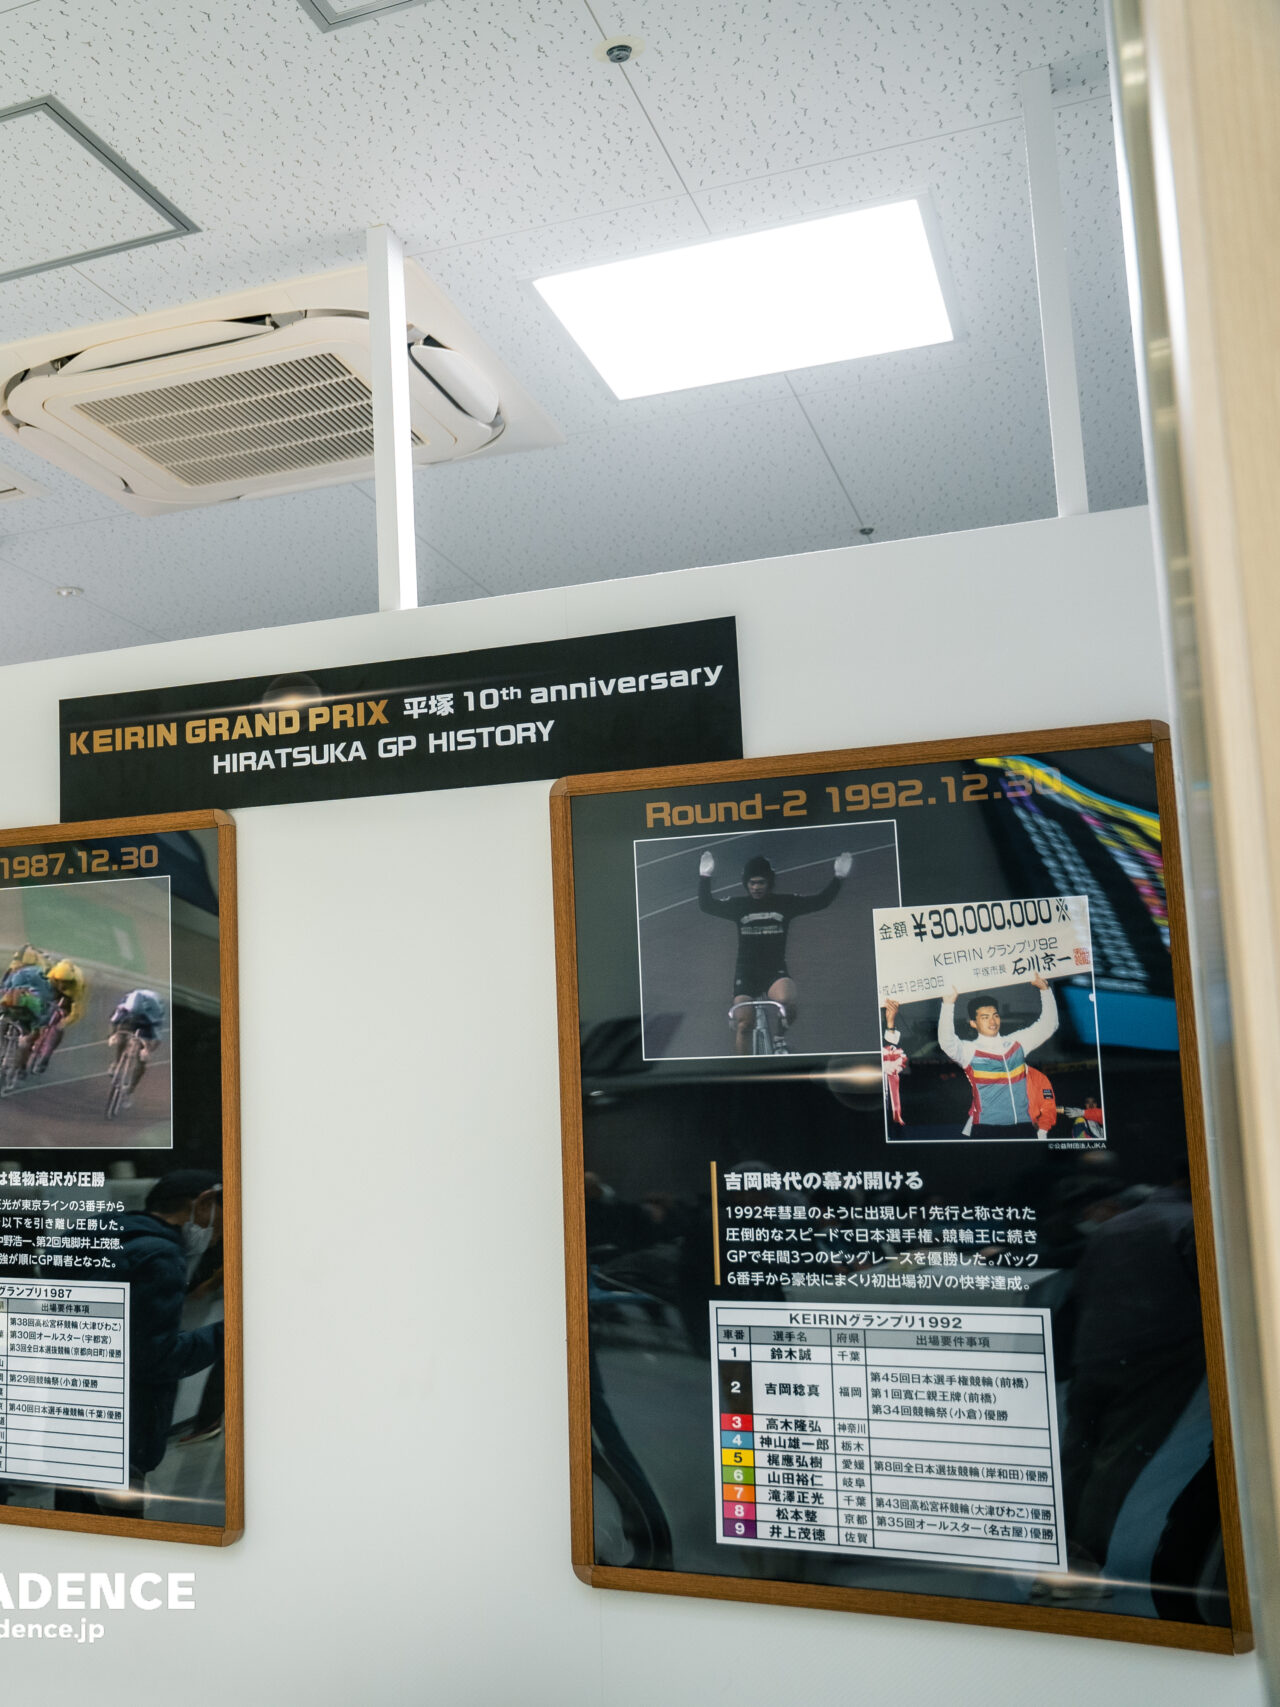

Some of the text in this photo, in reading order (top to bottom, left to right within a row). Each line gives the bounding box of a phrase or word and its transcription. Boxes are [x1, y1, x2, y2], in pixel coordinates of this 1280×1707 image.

[69, 663, 723, 755] KEIRIN GRAND PRIX 平塚 10th anniversary
[212, 719, 555, 775] HIRATSUKA GP HISTORY
[646, 767, 1062, 828] Round-2 1992.12.30
[0, 845, 159, 880] 1987.12.30
[878, 921, 908, 941] 金額
[933, 948, 983, 967] KEIRIN
[880, 976, 944, 996] 成4年12月30日
[723, 1170, 923, 1191] 吉岡時代の幕が開ける
[725, 1205, 1036, 1222] 1992年彗星のように出現しF1先行と称された
[726, 1227, 1037, 1244] 圧倒的なスピードで日本選手権、競輪王に続き
[726, 1250, 1039, 1267] GPで年間3つのビッグレースを優勝した。バック
[727, 1271, 1031, 1291] 6番手から豪快にまくり初出場初Vの快挙達成。
[41, 1303, 90, 1314] 出場要件事項
[789, 1312, 962, 1330] KEIRINグランプリ1992
[723, 1329, 990, 1349] 車番 選手名 府県 出場要件事項
[730, 1346, 861, 1362] 1 鈴木誠 千葉
[730, 1381, 741, 1394] 2
[839, 1385, 862, 1399] 福岡
[870, 1370, 1030, 1390] 第45回日本選手権競輪(前橋)
[870, 1387, 998, 1405] 第1回寛仁親王牌(前橋)
[872, 1404, 1009, 1422] 第34回競輪祭(小倉)優勝
[732, 1416, 866, 1436] 3 高木隆弘 神奈川
[731, 1434, 864, 1453] 4 神山雄一郎 栃木
[733, 1452, 743, 1464] 5
[842, 1458, 865, 1471] 愛媛
[873, 1460, 1049, 1483] 第8回全日本選抜競輪(岸和田)優勝
[733, 1469, 866, 1489] 6 山田裕仁 岐阜
[733, 1487, 1052, 1521] 7 滝澤正光 千葉 第43回高松宮杯競輪(大津びわこ)優勝
[734, 1504, 1054, 1541] 8 松本整 京都 第35回オールスター(名古屋)優勝
[734, 1522, 868, 1544] 9 井上茂徳 佐賀
